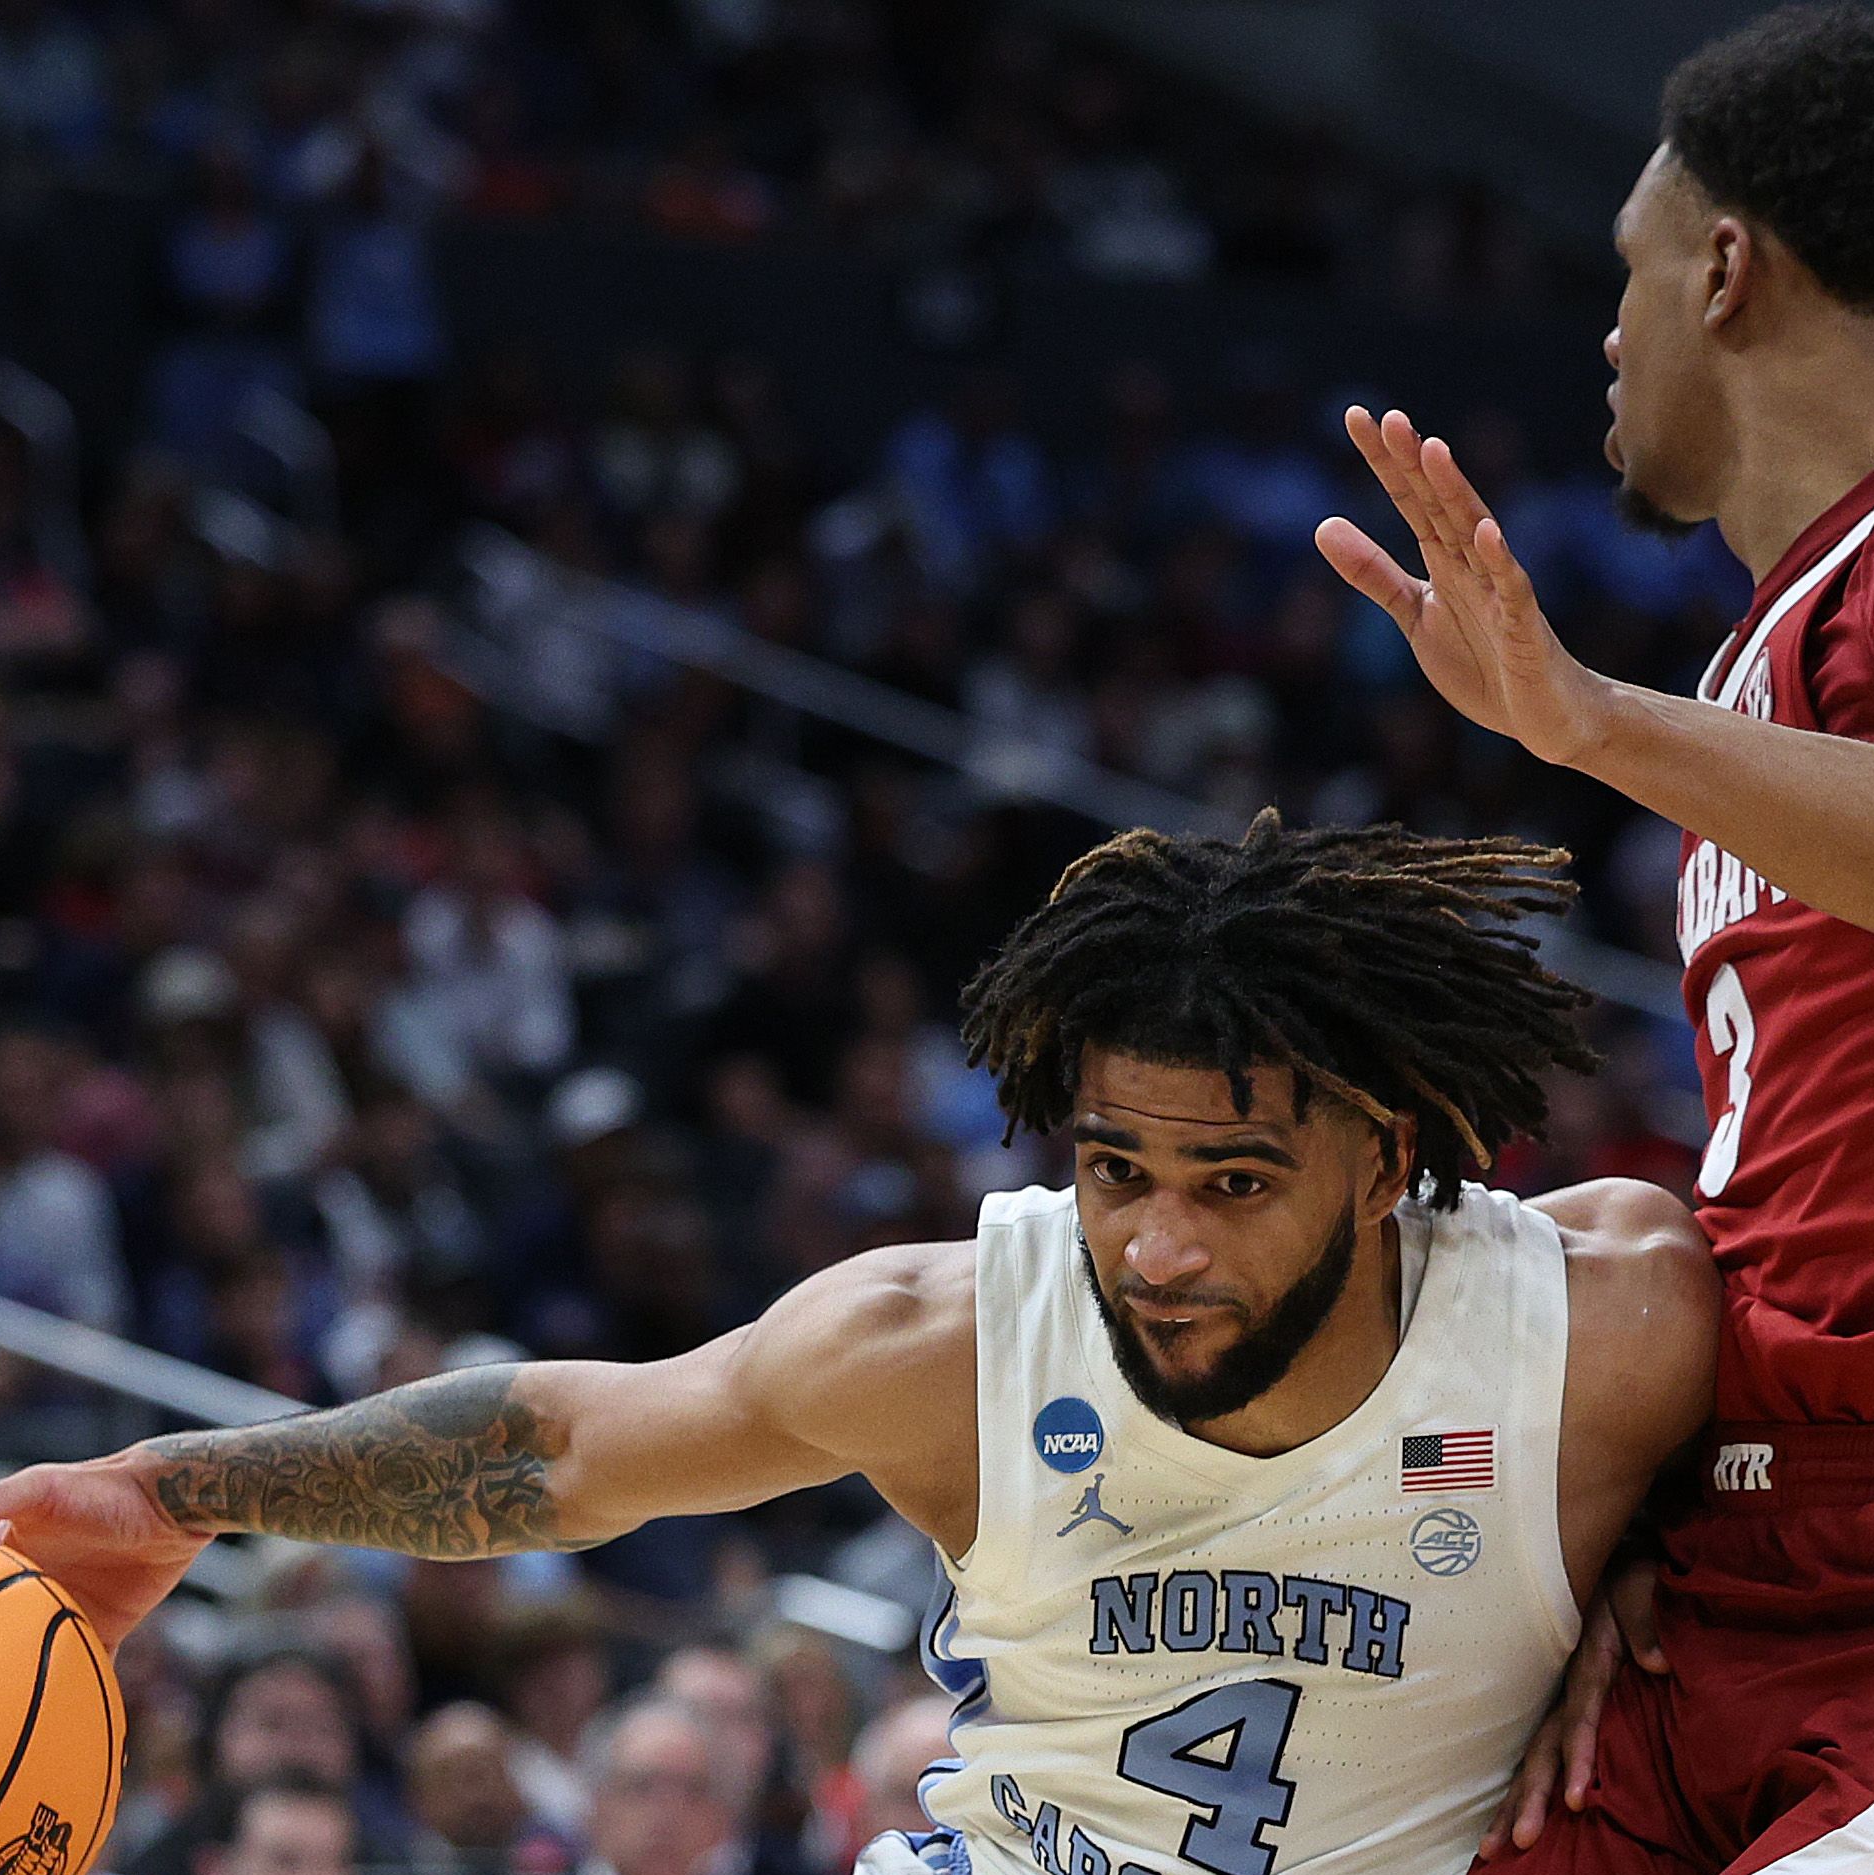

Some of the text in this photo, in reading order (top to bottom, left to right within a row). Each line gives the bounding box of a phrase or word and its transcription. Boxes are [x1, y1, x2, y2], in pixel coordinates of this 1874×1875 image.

[1697, 961, 1756, 1199] 3
[1042, 1432, 1100, 1455] NCAA
[1712, 1443, 1774, 1492] RTR
[1414, 1530, 1480, 1552] ACC
[1088, 1569, 1412, 1679] NORTH
